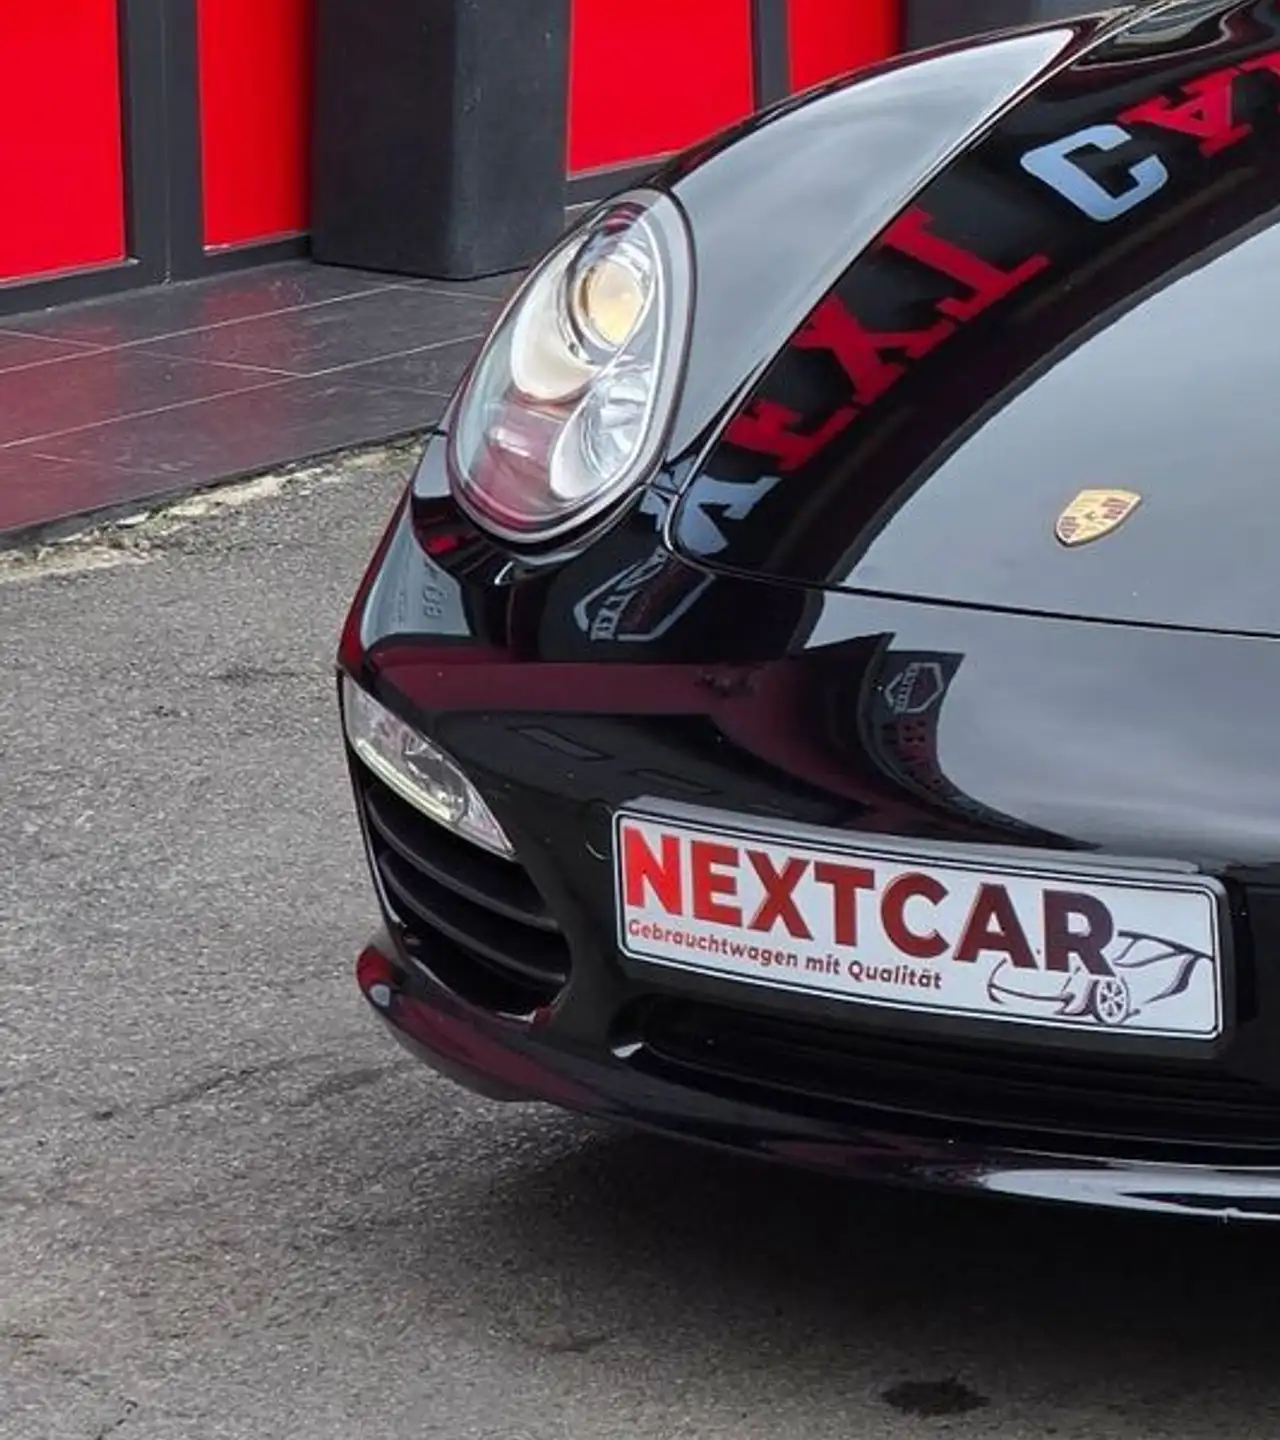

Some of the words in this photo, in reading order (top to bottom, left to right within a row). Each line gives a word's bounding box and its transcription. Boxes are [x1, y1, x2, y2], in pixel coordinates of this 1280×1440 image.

[624, 826, 1116, 977] NEXTCAR
[628, 919, 798, 966] Gebrauchtwagen
[805, 953, 841, 975] mit
[847, 959, 942, 990] Qualität
